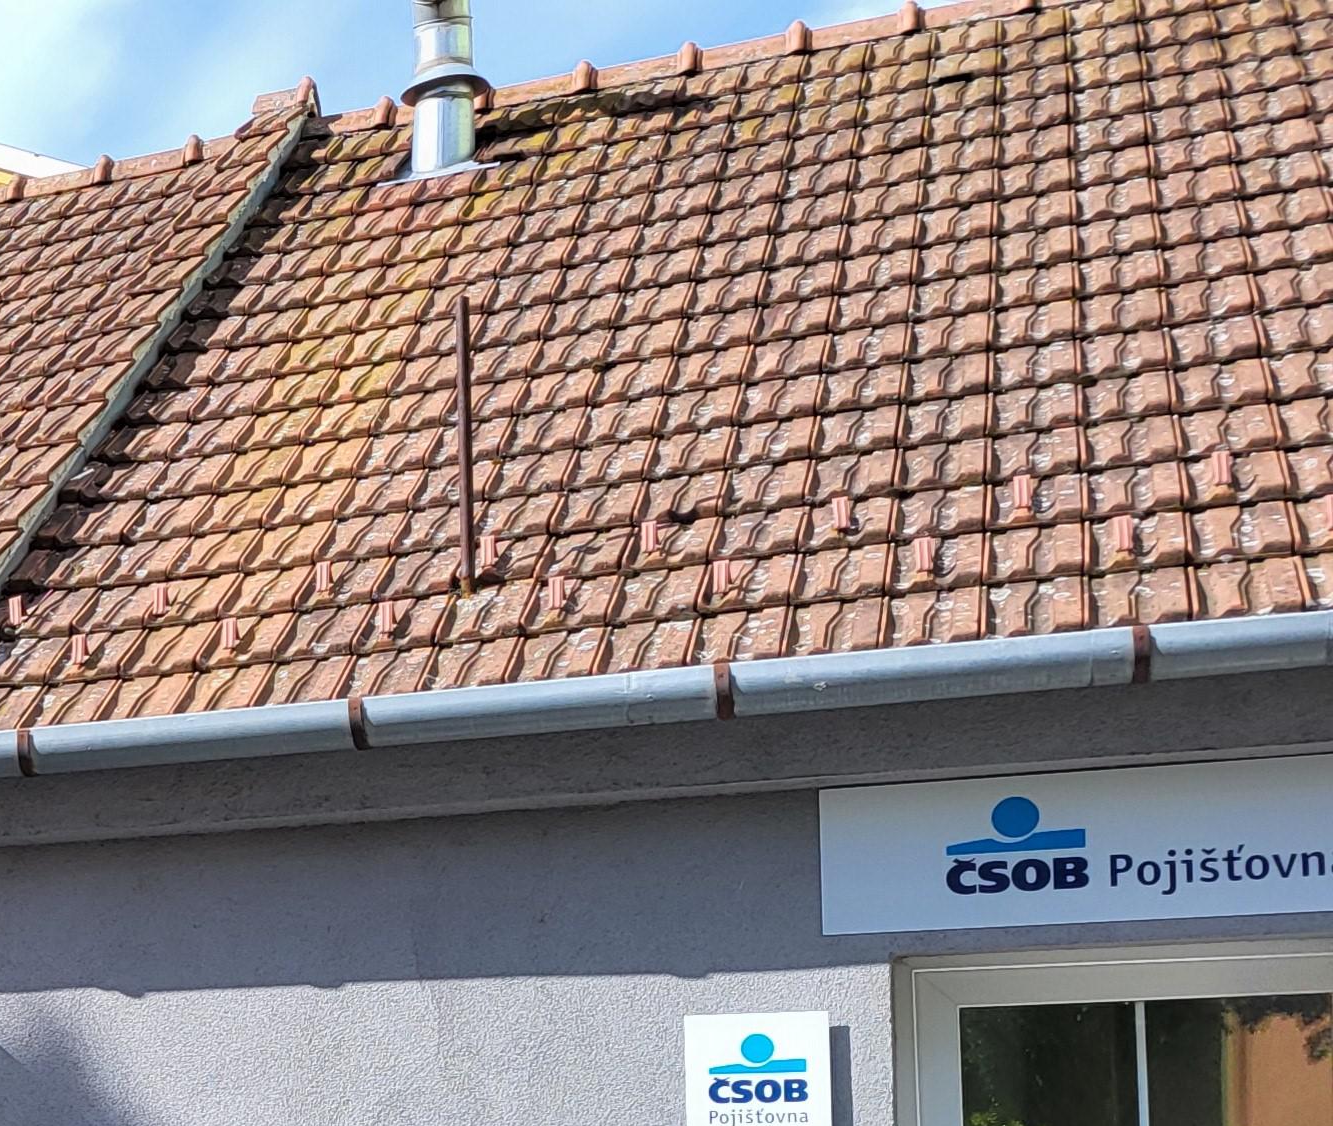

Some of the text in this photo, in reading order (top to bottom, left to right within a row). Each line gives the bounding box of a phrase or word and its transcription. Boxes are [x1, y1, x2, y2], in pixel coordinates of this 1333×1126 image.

[945, 844, 1333, 895] ČSOB Pojišťovn
[709, 1077, 808, 1103] ČSOB
